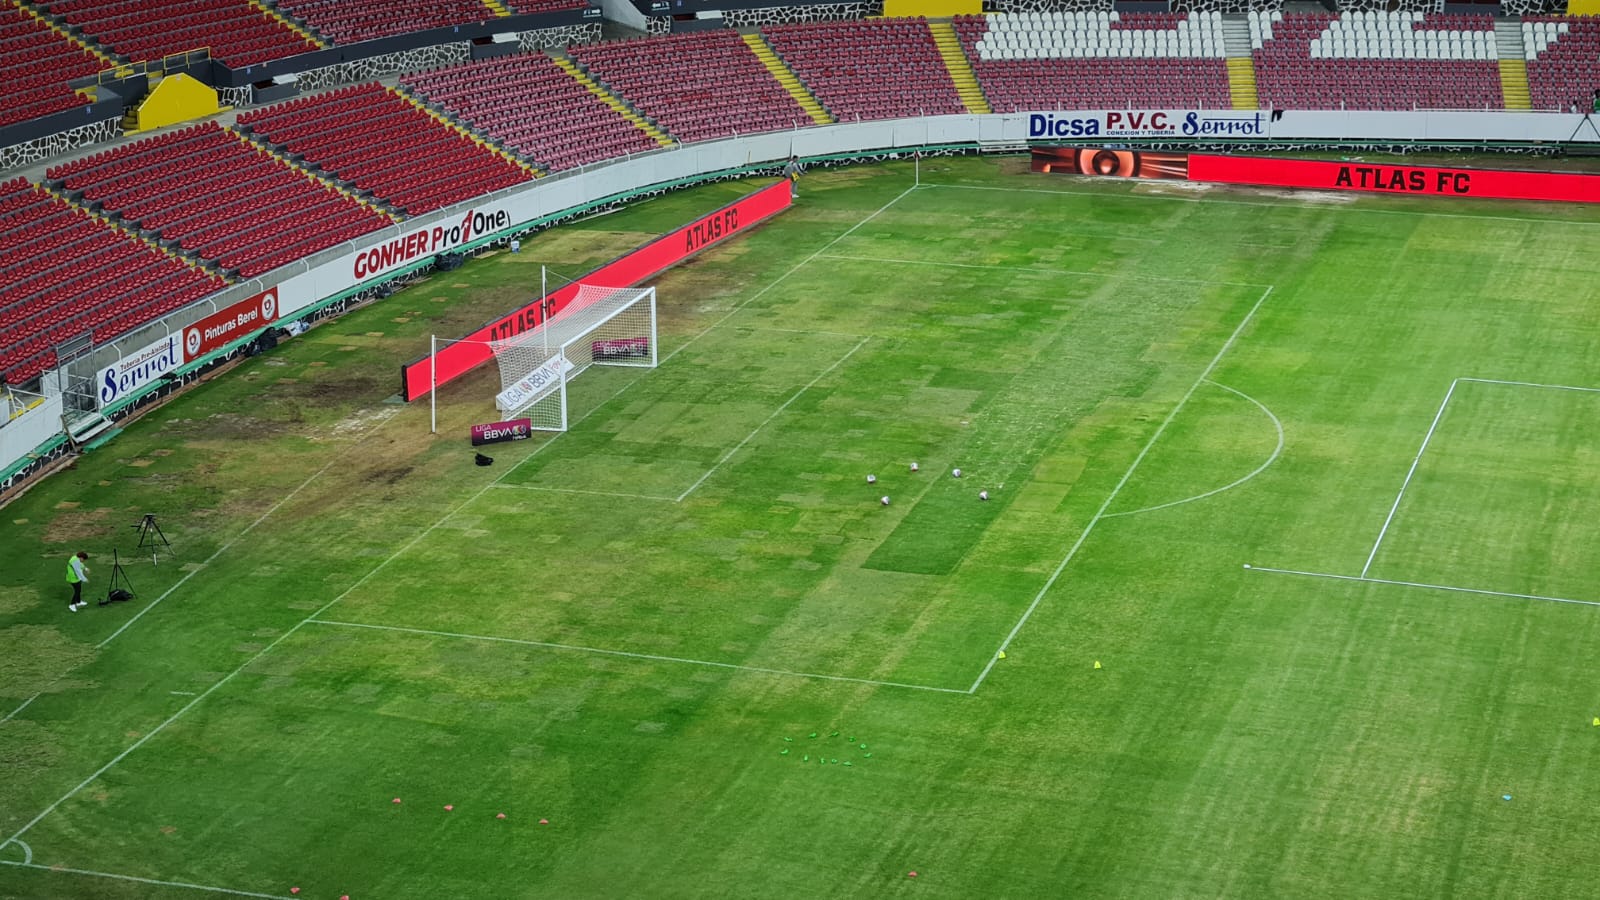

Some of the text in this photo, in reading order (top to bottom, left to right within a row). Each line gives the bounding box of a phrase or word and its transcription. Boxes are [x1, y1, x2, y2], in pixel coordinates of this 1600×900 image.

[1030, 114, 1099, 136] Dicsa
[1107, 112, 1175, 130] P.V.C.
[1182, 111, 1265, 135] Serrot
[1335, 167, 1471, 194] ATLAS FC
[686, 208, 738, 252] ATLAS FC
[354, 229, 429, 279] GONHER
[204, 319, 236, 342] Pinturas
[237, 307, 258, 327] Berel
[102, 337, 178, 403] Serrot
[527, 366, 554, 389] BBVA
[475, 424, 492, 432] LIGA
[484, 427, 513, 440] BBVA
